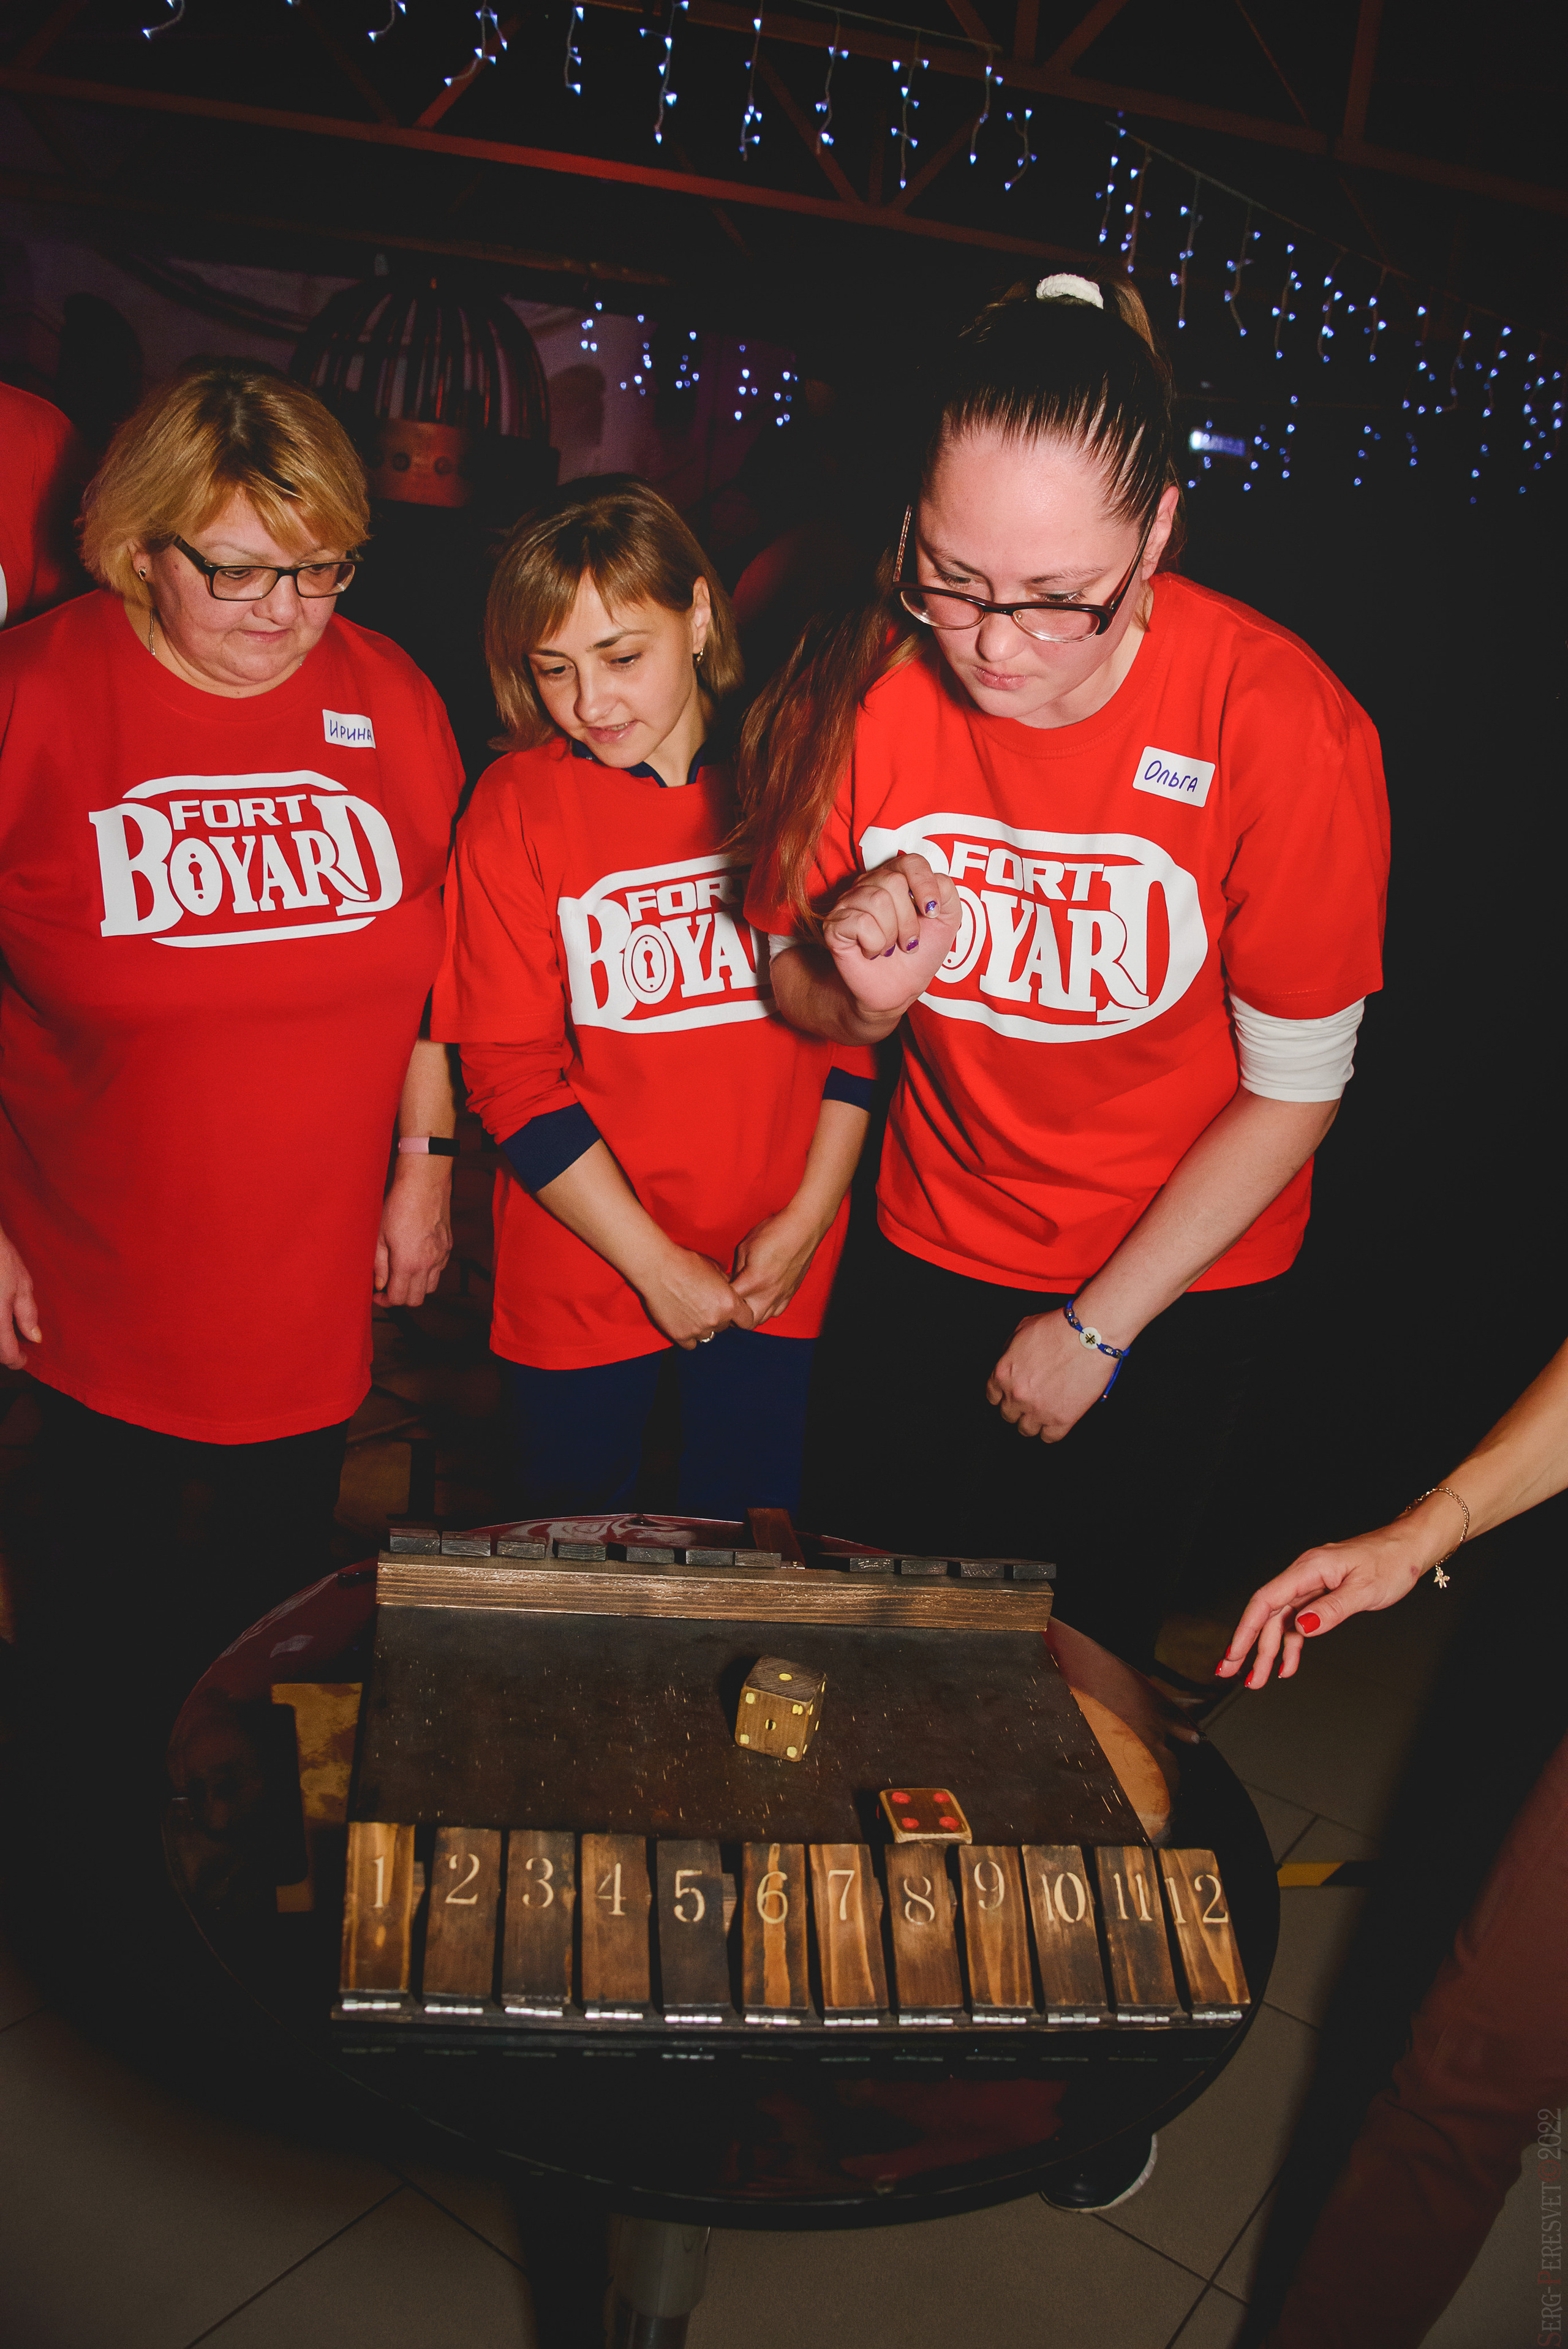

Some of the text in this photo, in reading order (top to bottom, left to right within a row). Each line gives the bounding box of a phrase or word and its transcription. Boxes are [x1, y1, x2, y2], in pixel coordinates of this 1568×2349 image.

[330, 719, 373, 741] ИРИНА
[169, 794, 307, 831] FORT
[88, 794, 403, 937] BOYARD
[949, 841, 1104, 901] FORT
[625, 875, 740, 922] FOR
[557, 897, 769, 1025] BOYA
[372, 1853, 1229, 1925] 1 2 3 4 5 6 7 8 9 10 11 12
